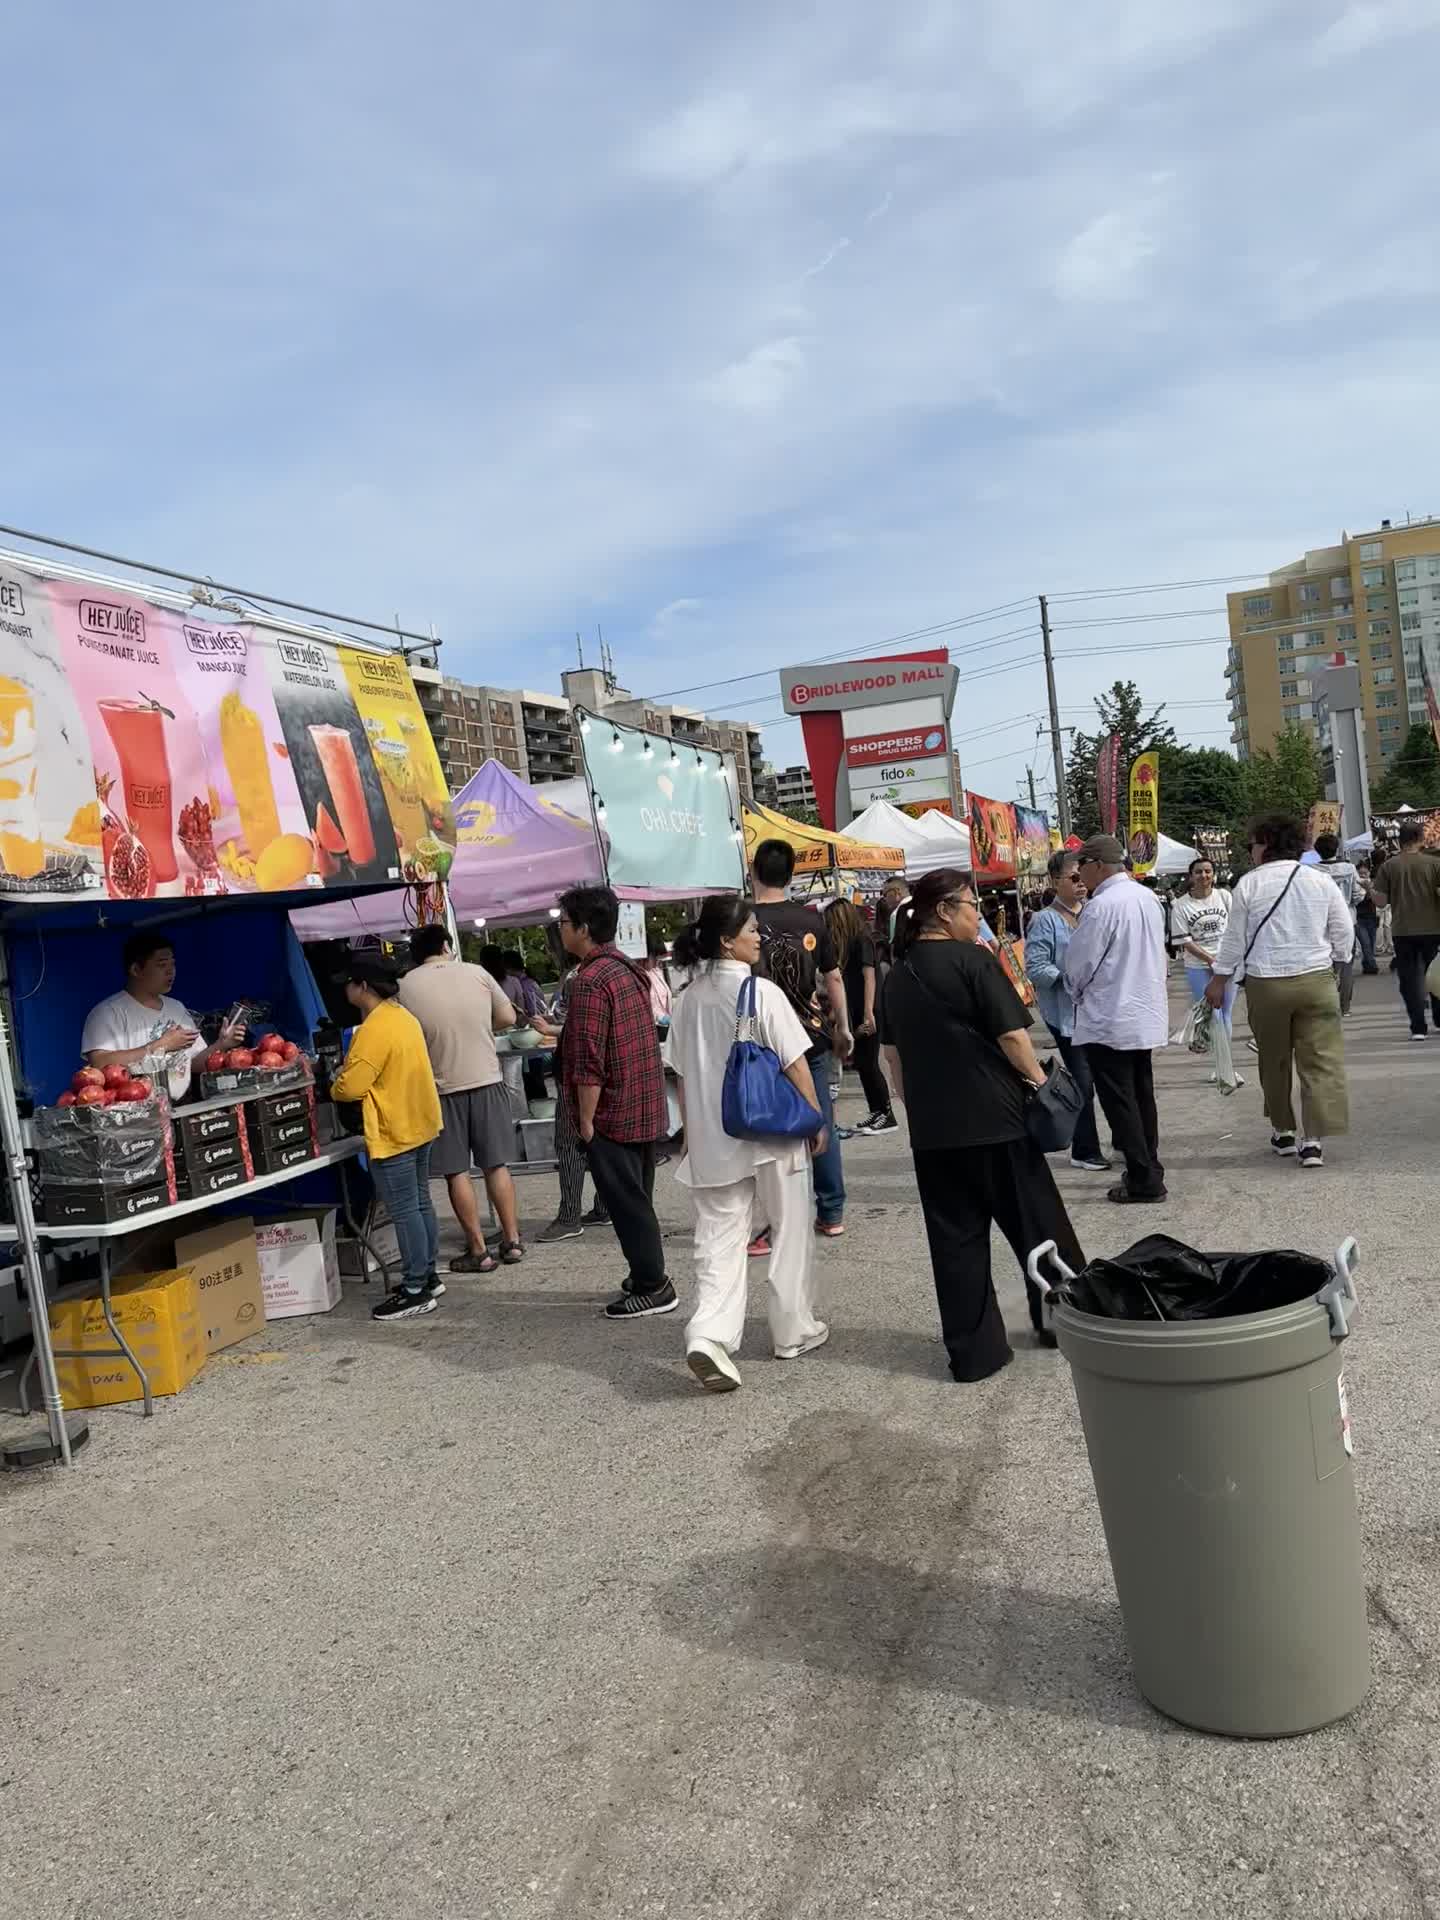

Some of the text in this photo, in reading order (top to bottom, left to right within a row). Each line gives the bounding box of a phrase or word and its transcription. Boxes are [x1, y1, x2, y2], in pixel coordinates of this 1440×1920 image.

[88, 606, 111, 628] HEY
[77, 634, 160, 665] POMEGRANATE JUICE
[189, 631, 208, 650] HEY
[283, 645, 300, 662] HEY
[197, 661, 231, 672] MANGO
[792, 668, 945, 704] BRIDLEWOOD MALL
[849, 735, 923, 754] SHOPPERS
[878, 744, 922, 756] DRUG MART
[881, 768, 905, 781] fido
[136, 1195, 160, 1207] goldcup
